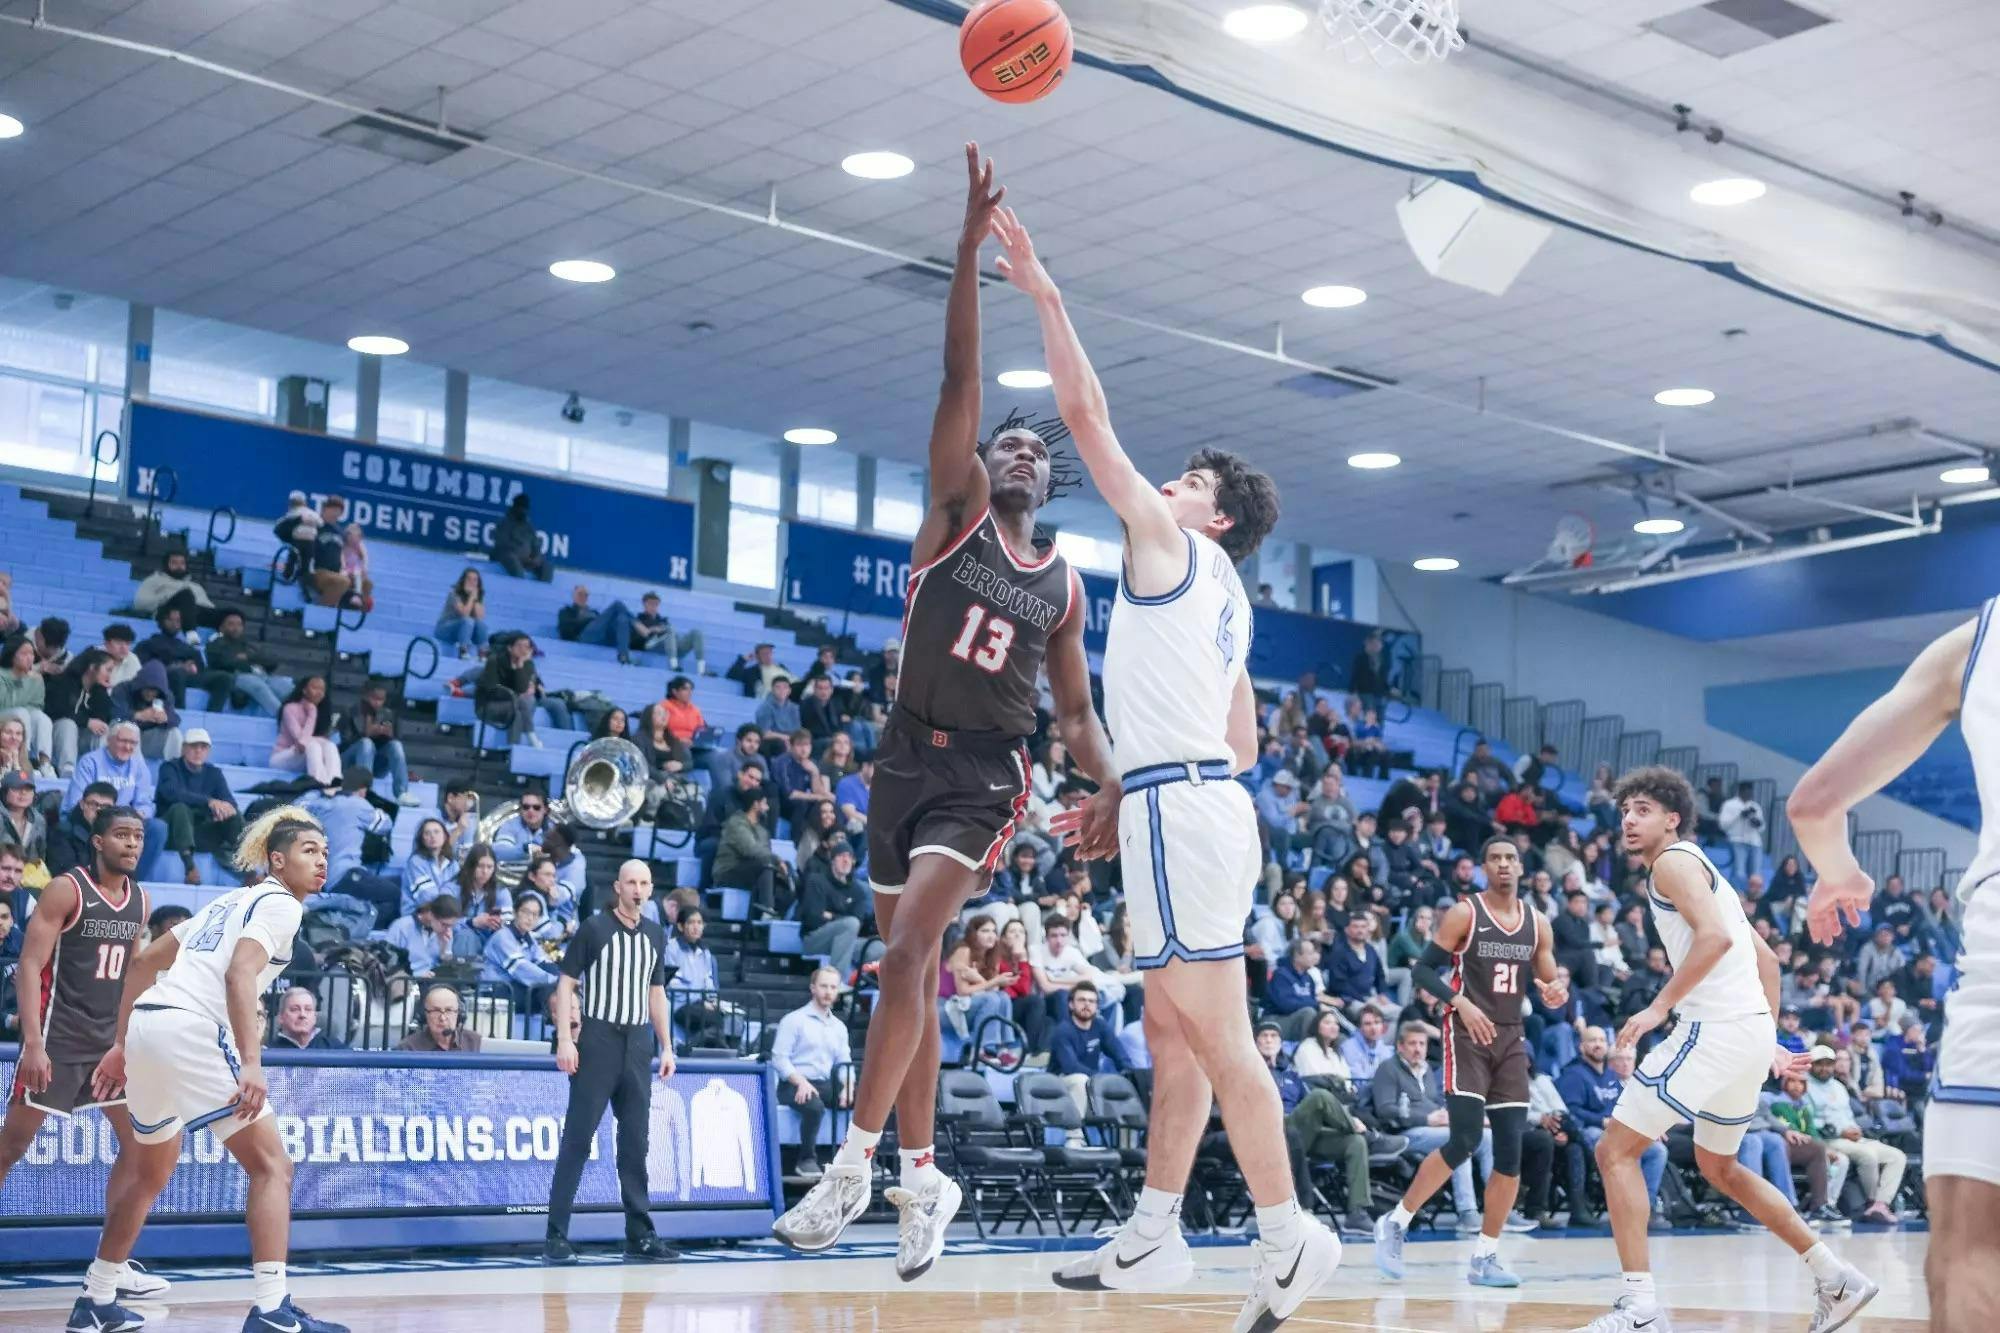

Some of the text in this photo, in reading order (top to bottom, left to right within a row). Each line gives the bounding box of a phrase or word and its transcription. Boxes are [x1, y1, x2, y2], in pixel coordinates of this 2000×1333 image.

[994, 41, 1051, 85] ELITE
[342, 450, 524, 507] COLUMBIA
[444, 516, 569, 559] SECON
[952, 552, 1058, 631] BROWN
[950, 603, 1015, 673] 13
[185, 903, 238, 952] 12
[95, 943, 126, 980] 10
[1492, 962, 1519, 994] 21
[506, 1205, 550, 1213] DAKTRONIC
